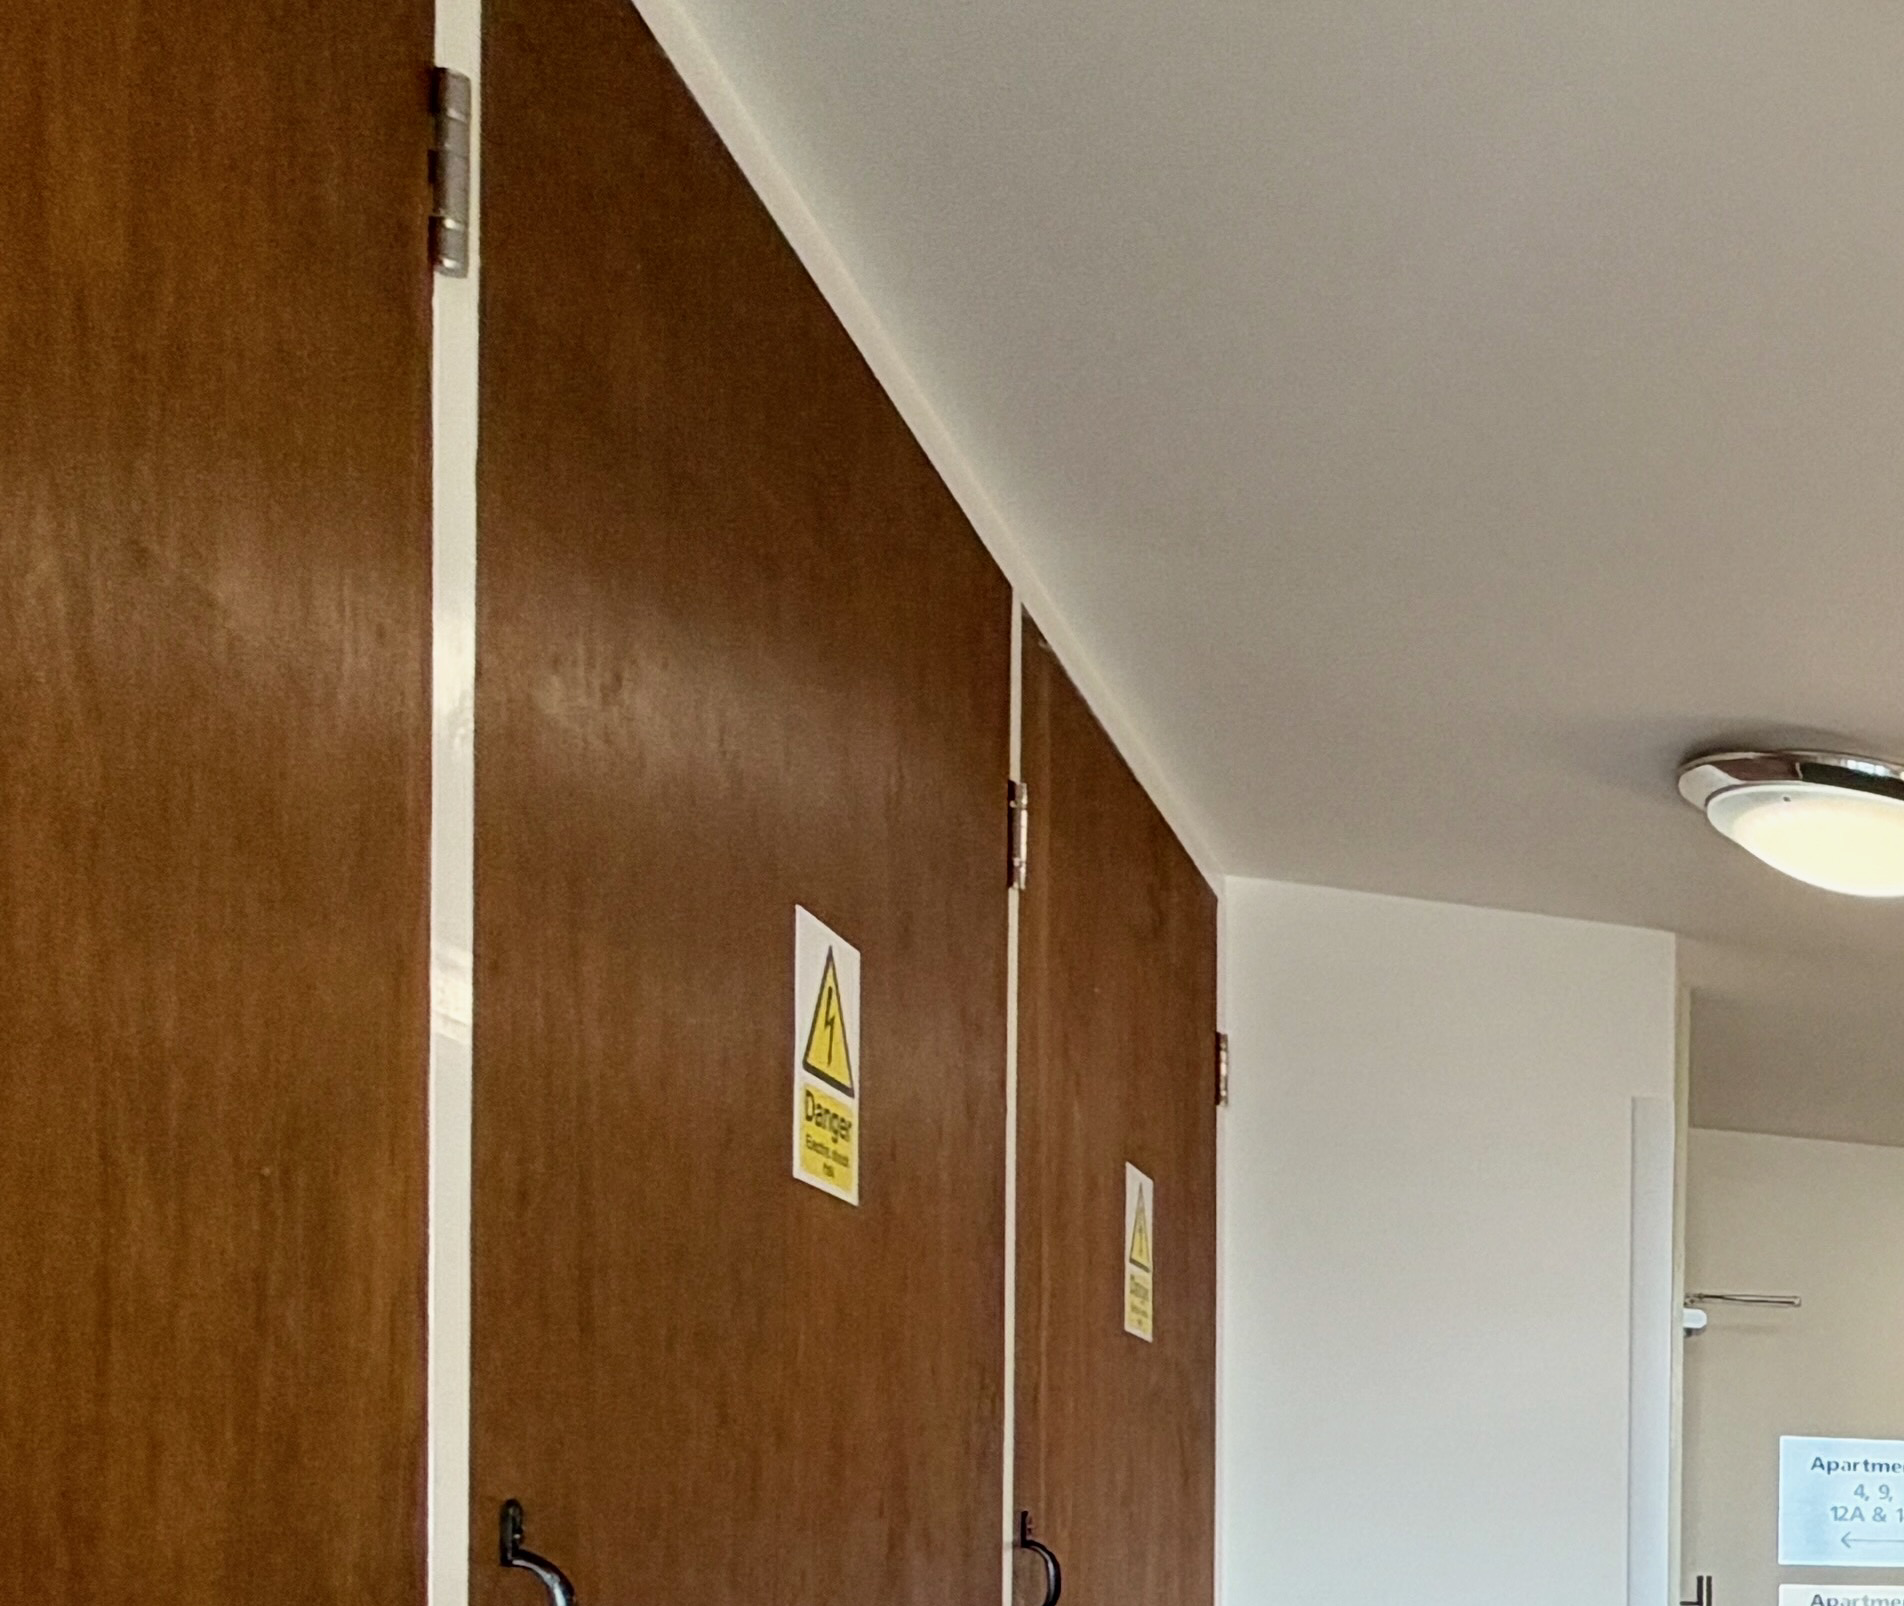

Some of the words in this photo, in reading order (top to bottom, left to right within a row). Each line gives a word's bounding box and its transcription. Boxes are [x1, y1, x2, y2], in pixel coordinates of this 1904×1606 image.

[805, 1089, 853, 1144] Danger
[1853, 1483, 1870, 1502] 4,
[1878, 1483, 1893, 1503] 9,
[1830, 1504, 1866, 1523] 12A
[1872, 1505, 1887, 1523] &
